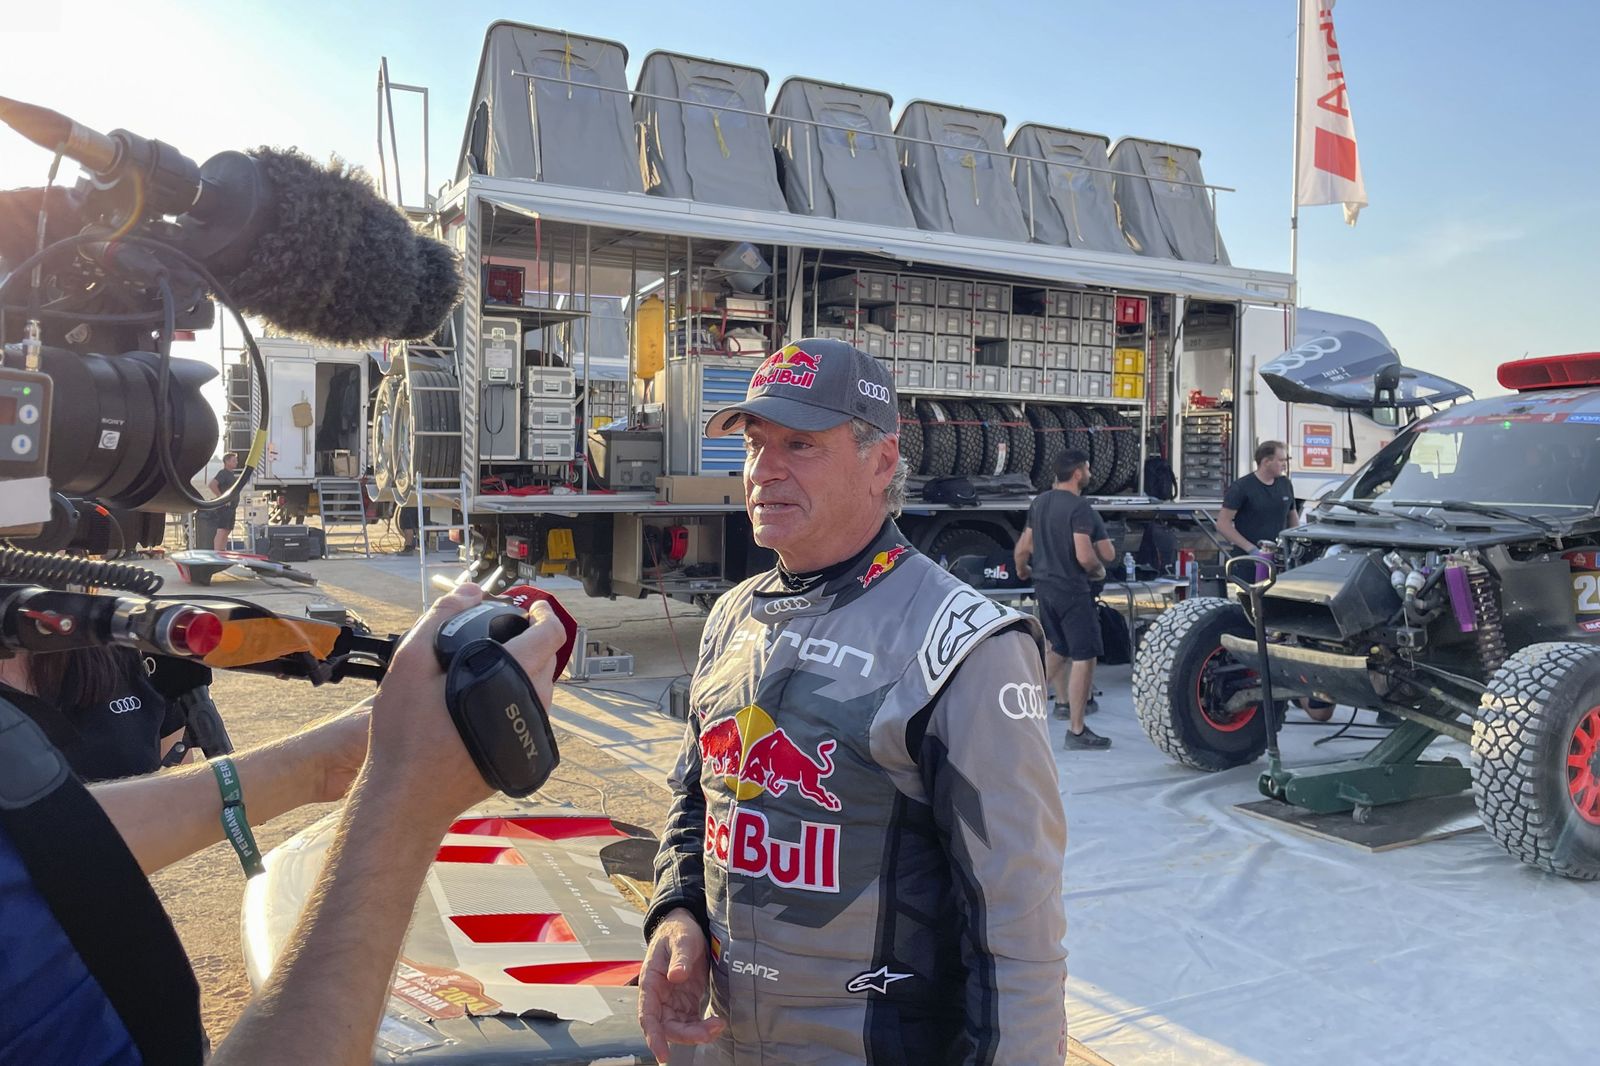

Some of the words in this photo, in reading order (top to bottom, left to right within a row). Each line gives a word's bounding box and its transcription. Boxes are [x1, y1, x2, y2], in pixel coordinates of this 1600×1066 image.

[752, 369, 779, 388] Red
[779, 368, 816, 389] Bull
[101, 417, 125, 425] SONY
[1307, 447, 1329, 456] MOTUL
[1574, 575, 1600, 611] 2
[505, 703, 539, 760] SONY
[730, 809, 839, 891] Bull
[731, 960, 780, 981] SAINZ
